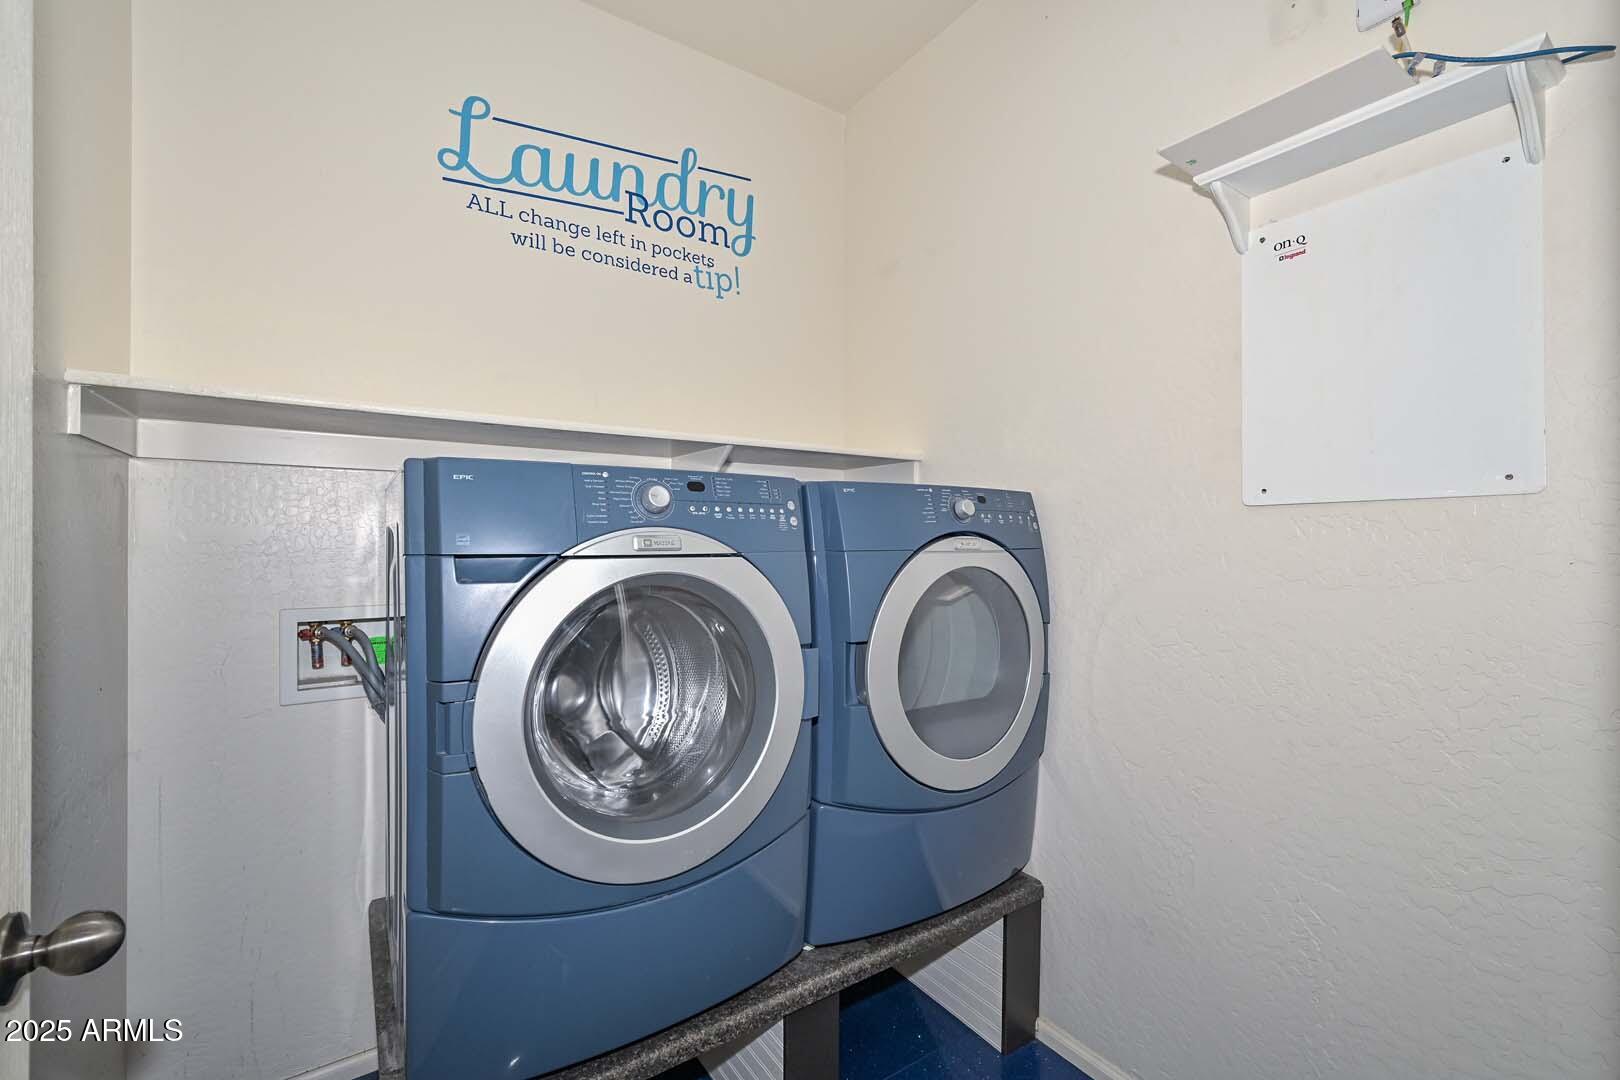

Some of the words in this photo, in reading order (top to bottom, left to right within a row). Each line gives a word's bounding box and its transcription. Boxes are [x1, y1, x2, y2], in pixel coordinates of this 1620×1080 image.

[437, 95, 756, 257] Laundry
[466, 193, 513, 219] ALL
[518, 207, 591, 239] change
[596, 225, 625, 247] left
[630, 235, 648, 252] in
[651, 243, 715, 268] pockets
[624, 190, 730, 249] Room
[510, 231, 546, 251] will
[552, 237, 576, 257] be
[581, 248, 679, 281] considered
[683, 271, 693, 285] a
[693, 265, 741, 299] tip!
